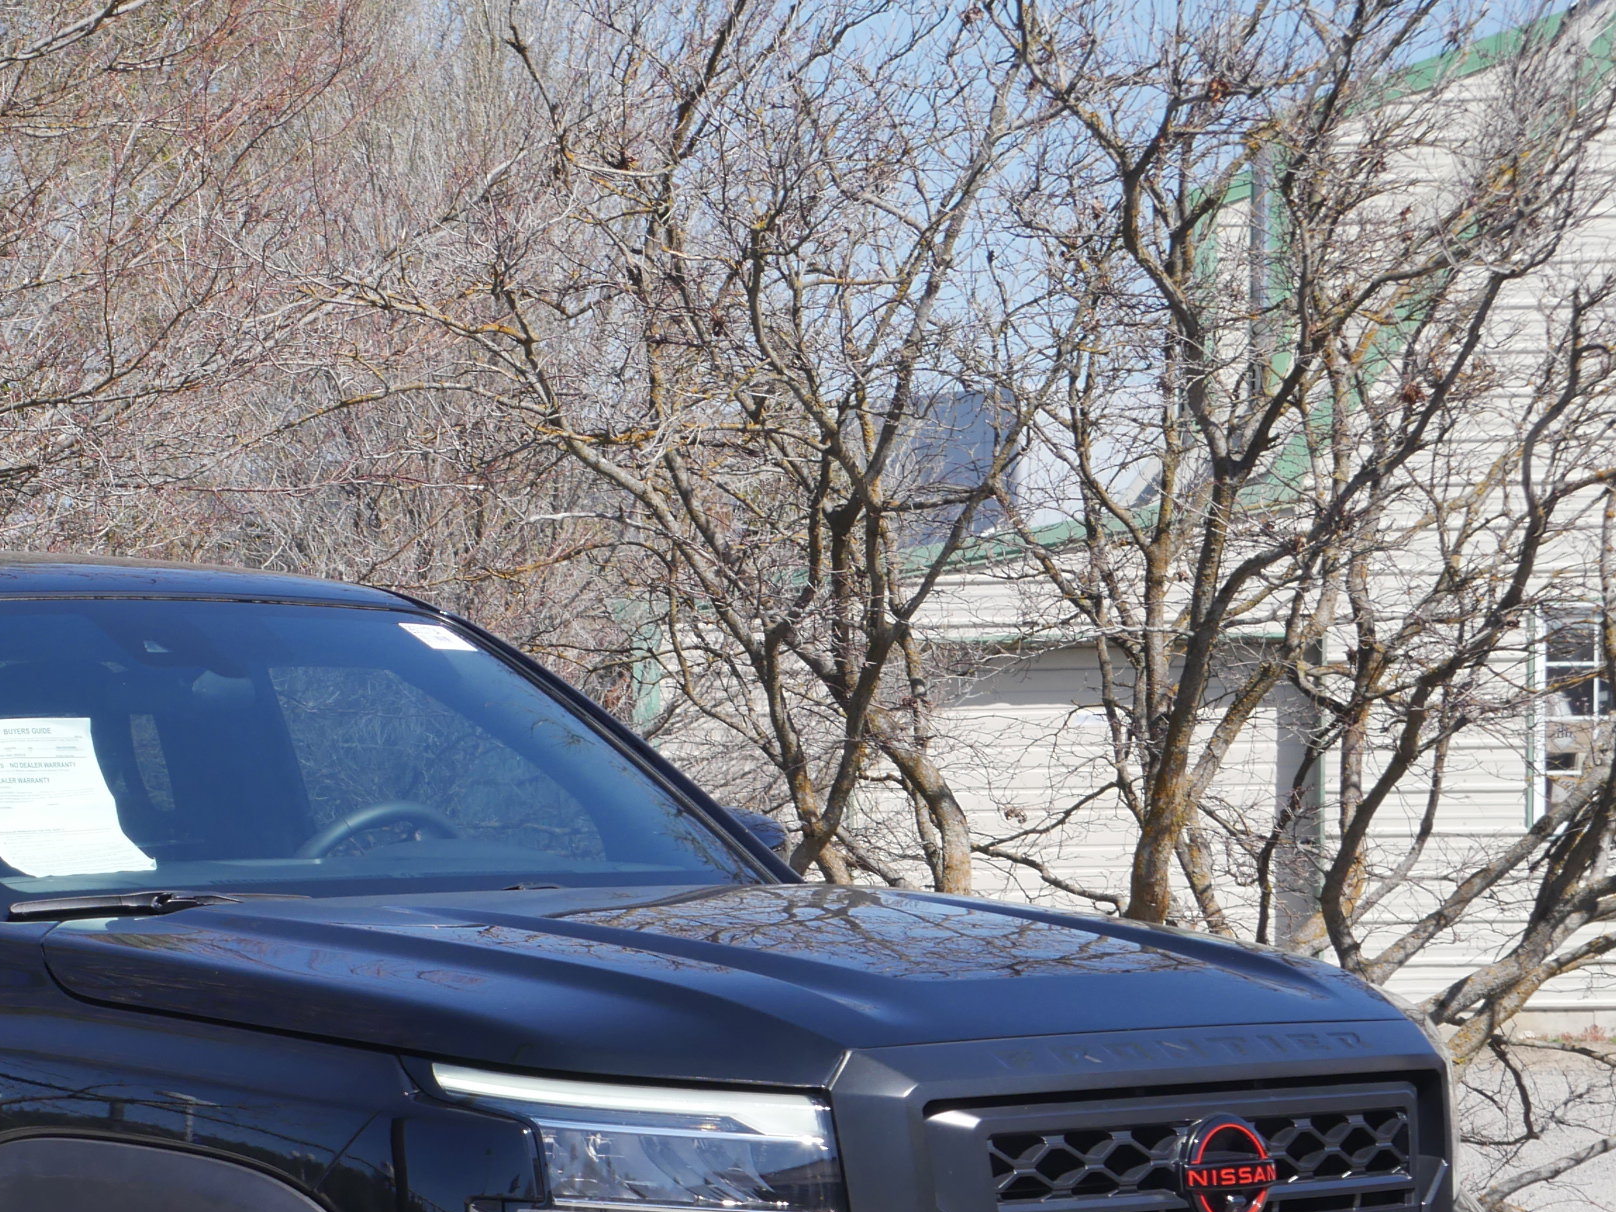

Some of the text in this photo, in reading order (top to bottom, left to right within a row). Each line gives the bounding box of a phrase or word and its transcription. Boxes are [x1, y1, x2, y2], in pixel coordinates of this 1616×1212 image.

[3, 726, 52, 736] BUYERS GUIDE
[1187, 1164, 1277, 1187] NISSAN
